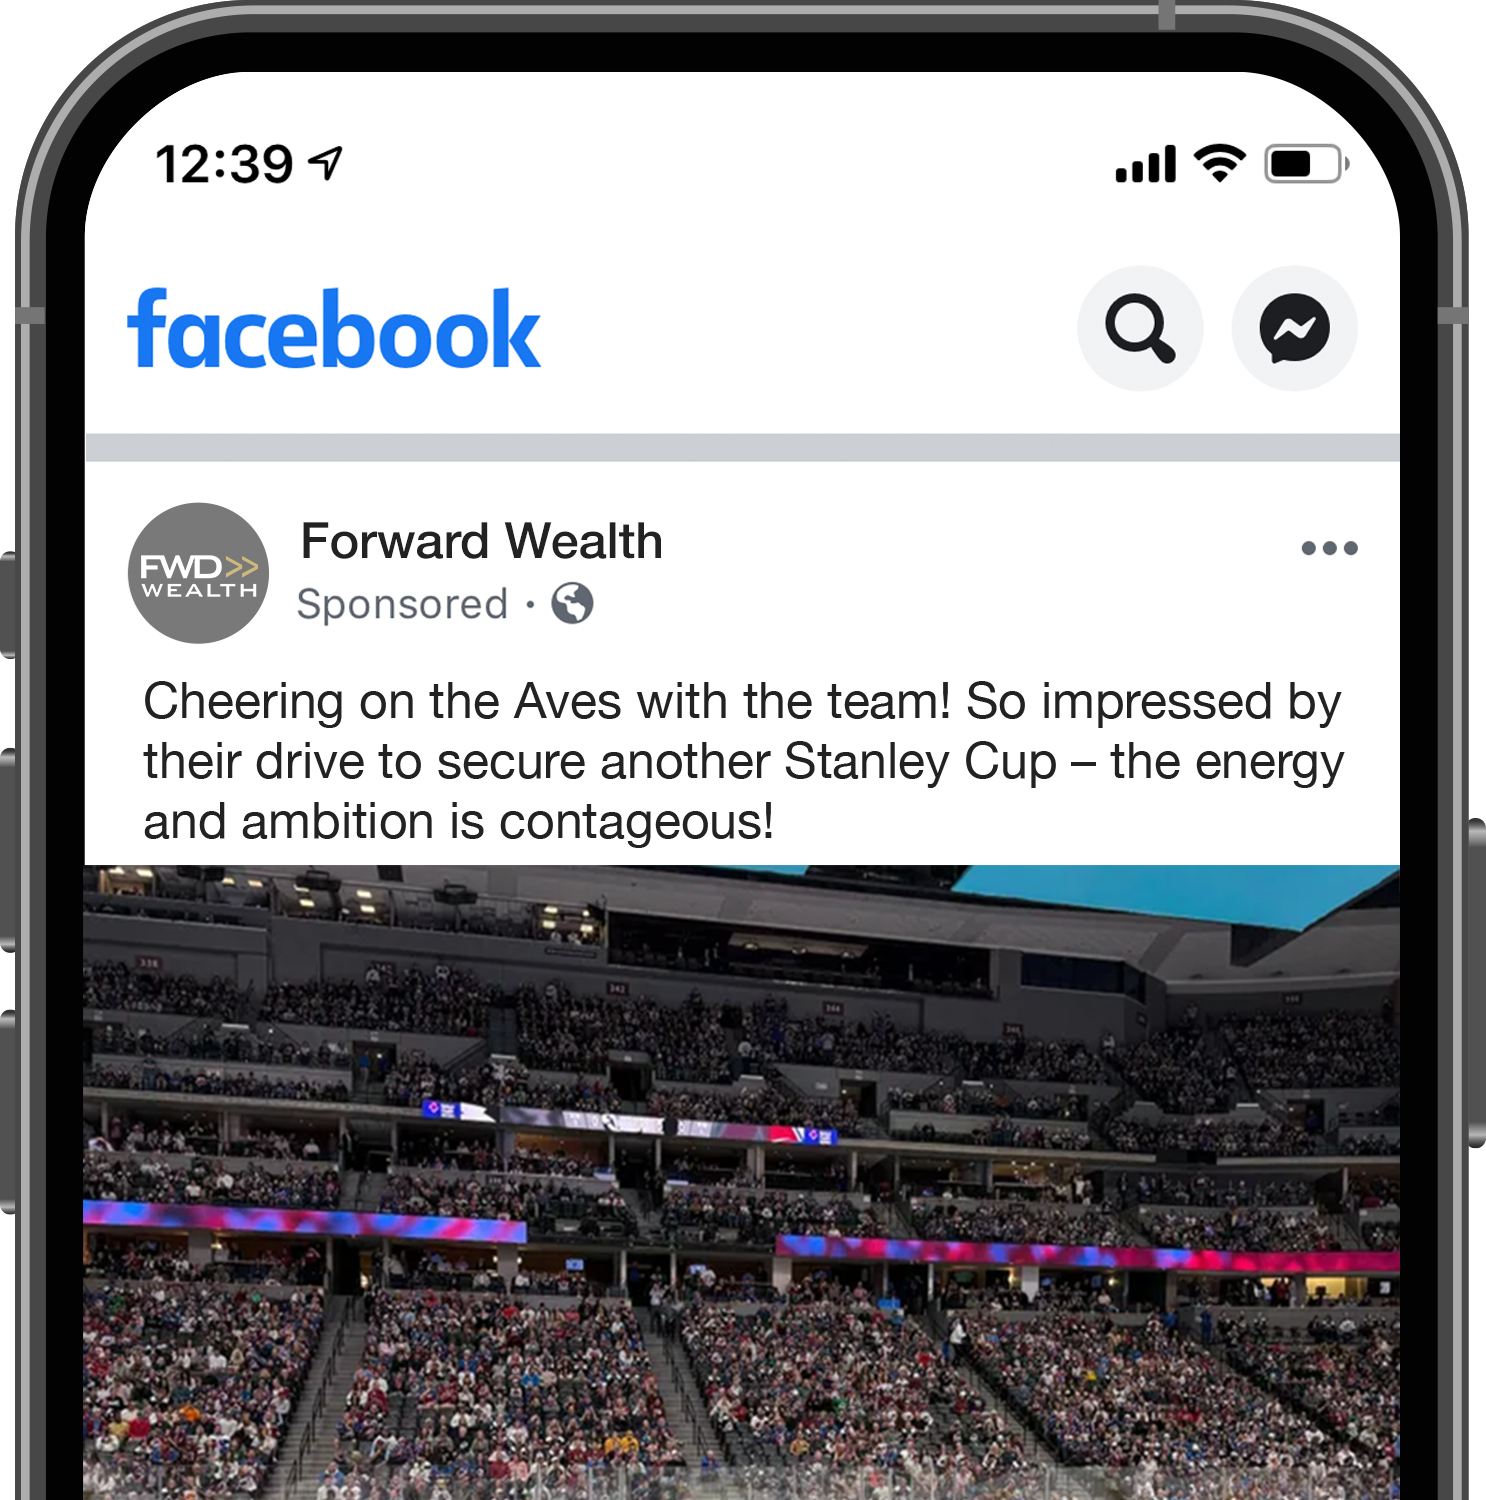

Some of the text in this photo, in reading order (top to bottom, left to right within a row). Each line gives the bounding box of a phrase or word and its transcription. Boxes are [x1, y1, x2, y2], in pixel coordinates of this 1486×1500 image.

[156, 143, 294, 185] 12:39
[127, 287, 541, 369] facebook
[303, 522, 662, 560] Forward Wealth
[141, 584, 257, 598] WEALTH
[297, 587, 507, 626] Sponsored
[145, 681, 1342, 728] Cheering on the Aves with the team! So impressed by
[143, 742, 242, 779] their
[256, 742, 364, 779] drive
[378, 744, 421, 779] to
[438, 751, 585, 779] secure
[601, 742, 771, 779] another
[785, 741, 950, 788] Stanley
[966, 741, 1056, 788] Cup
[1110, 742, 1180, 779] the
[1196, 751, 1345, 788] energy
[144, 802, 772, 848] and ambition is contageous!
